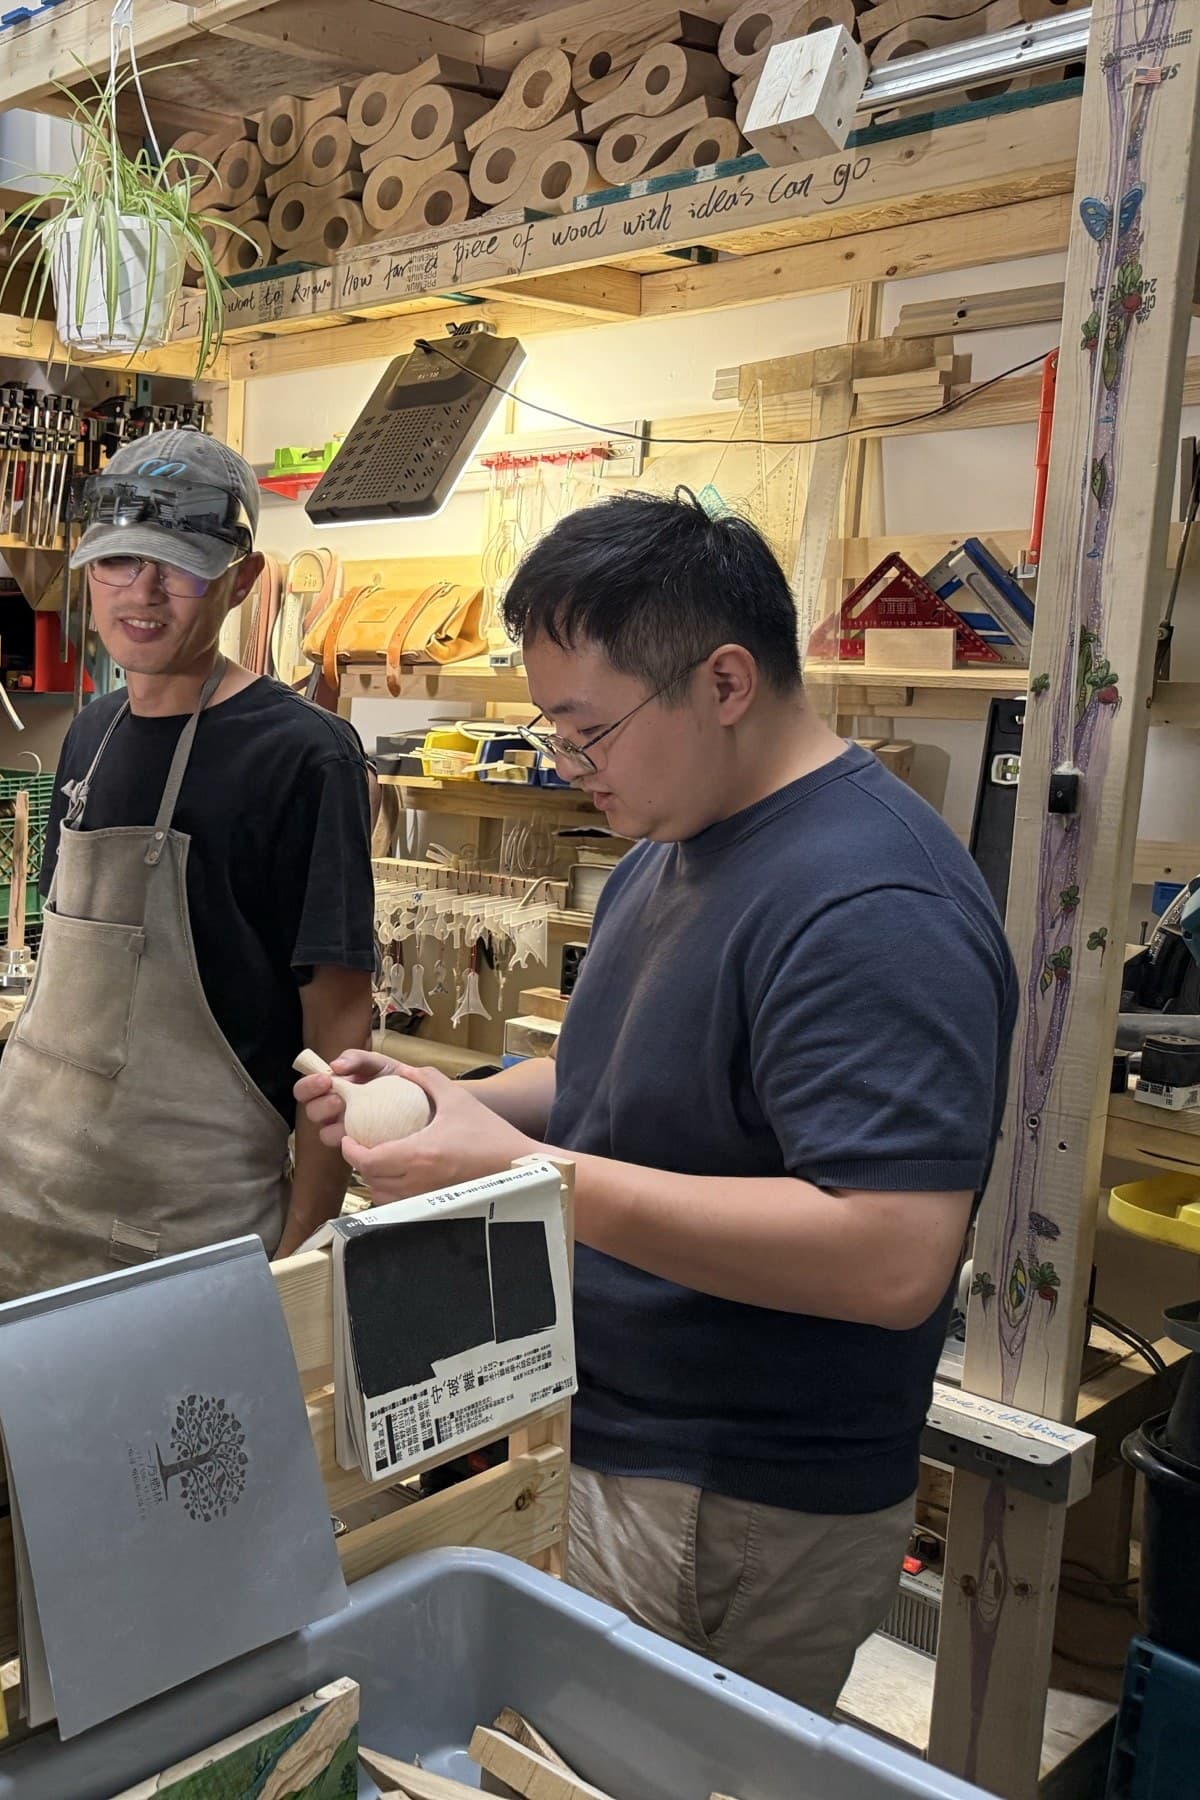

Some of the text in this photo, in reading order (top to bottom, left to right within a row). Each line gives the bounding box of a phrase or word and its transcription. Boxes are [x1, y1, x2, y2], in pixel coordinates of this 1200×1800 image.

[227, 290, 255, 313] want
[264, 285, 281, 305] to
[343, 266, 372, 296] how
[424, 257, 439, 274] a
[453, 235, 499, 267] piece
[552, 207, 608, 247] wood
[624, 192, 671, 235] with
